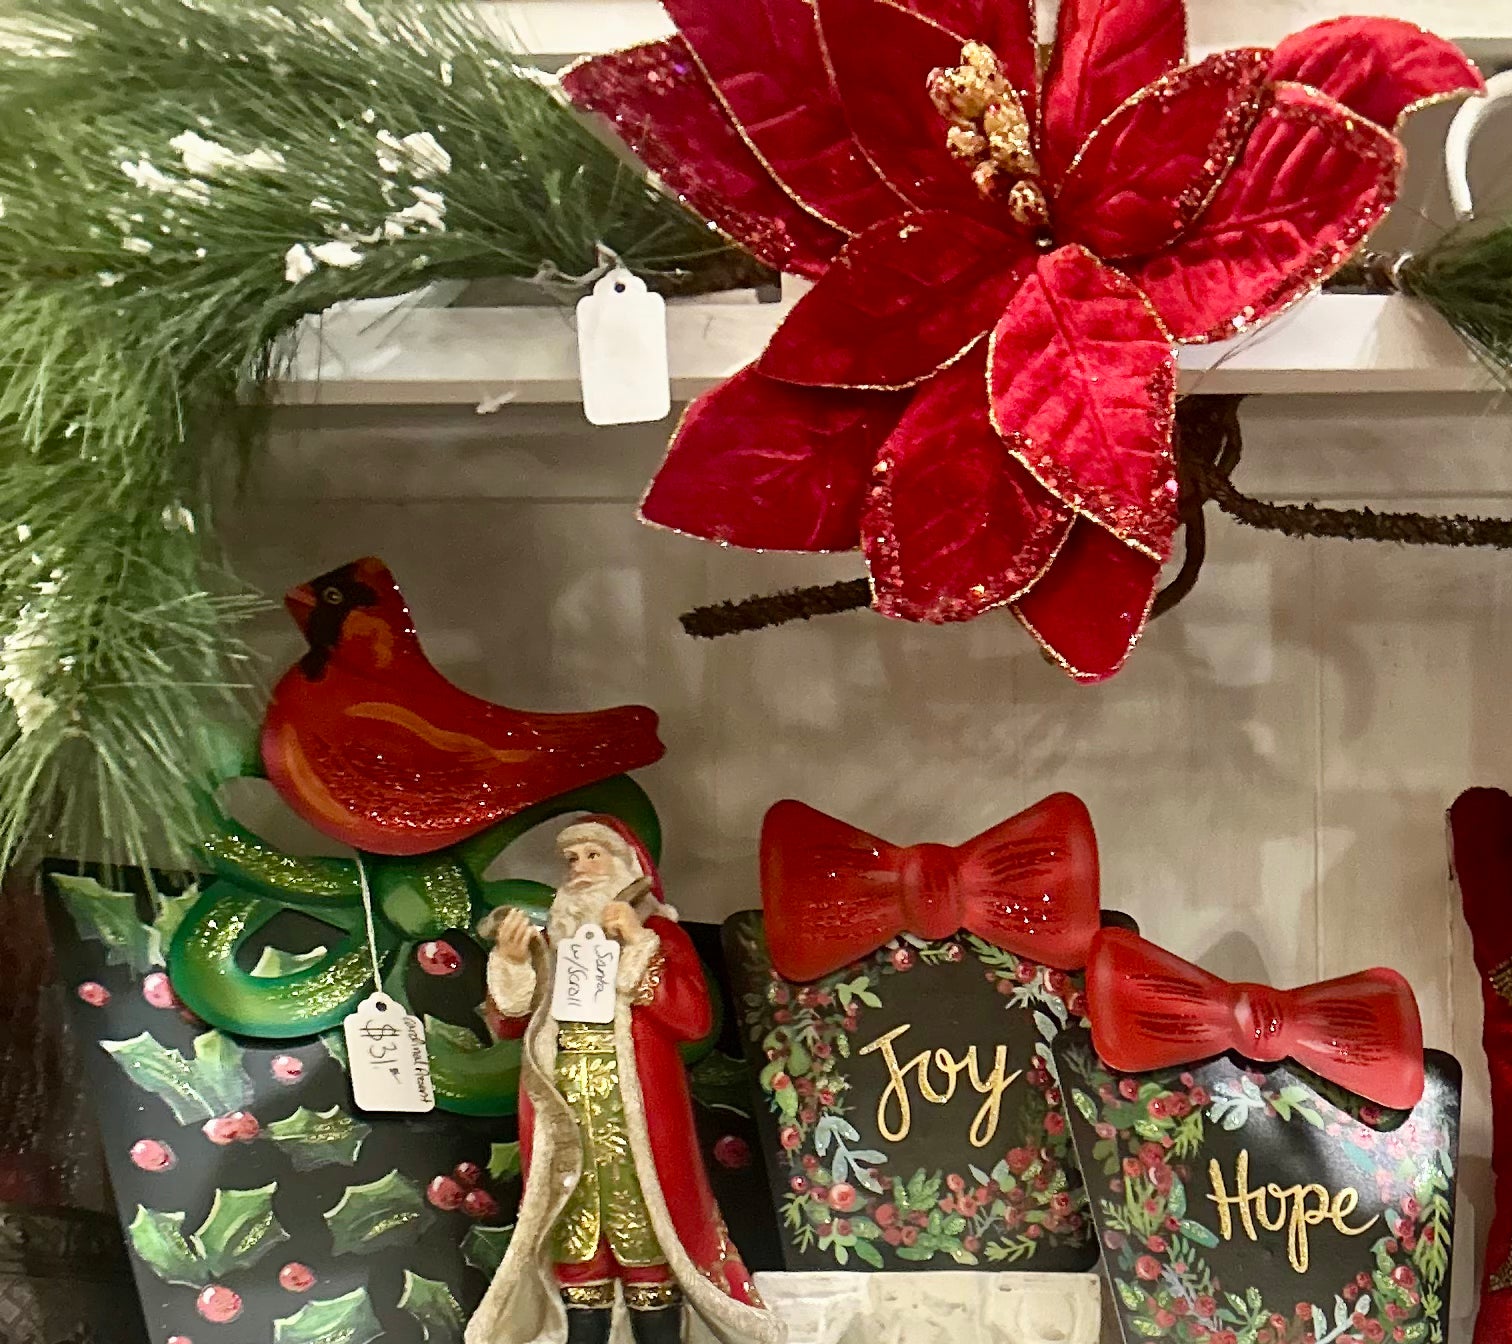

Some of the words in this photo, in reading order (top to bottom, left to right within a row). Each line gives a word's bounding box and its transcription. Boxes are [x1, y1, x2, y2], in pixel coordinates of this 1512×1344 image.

[594, 944, 614, 1003] Santa
[859, 1023, 1023, 1148] Joy
[1206, 1149, 1380, 1274] Hope
